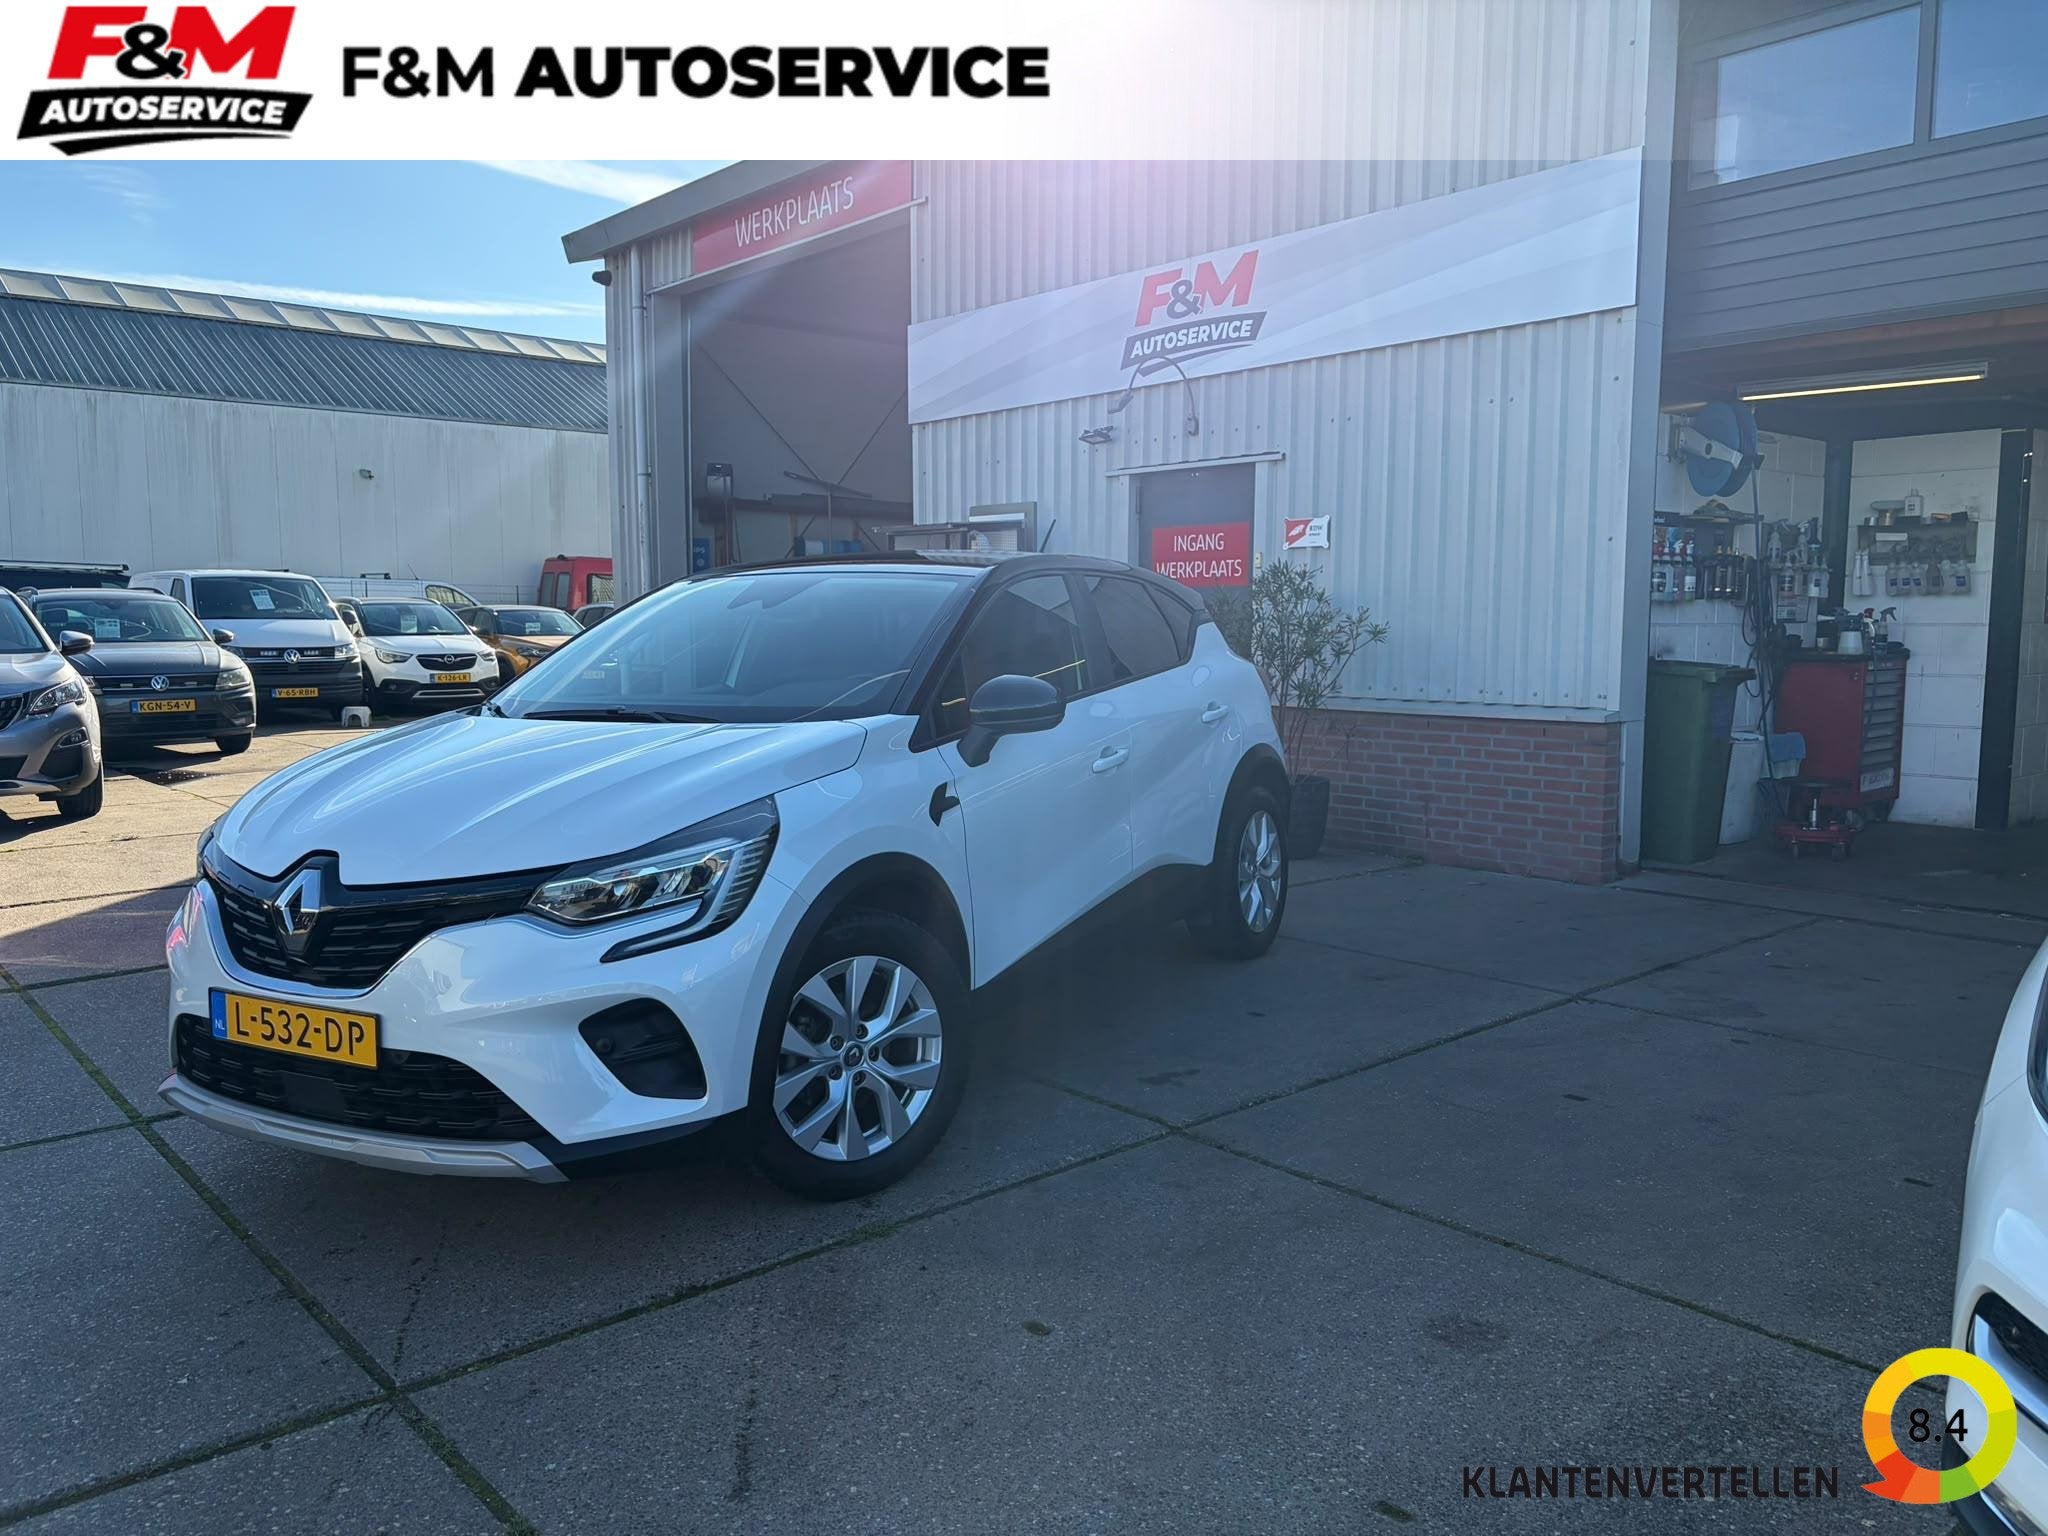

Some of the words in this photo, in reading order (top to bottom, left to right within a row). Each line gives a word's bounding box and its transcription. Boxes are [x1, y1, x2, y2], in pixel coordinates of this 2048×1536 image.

[734, 176, 855, 248] WERKPLAATS
[1134, 249, 1260, 328] F&M
[1130, 319, 1253, 359] AUTOSERVICE
[1173, 532, 1225, 552] INGANG
[1156, 559, 1242, 579] WERKPLAATS
[139, 700, 191, 712] KGN-54-V
[234, 1001, 365, 1056] L-532-DP
